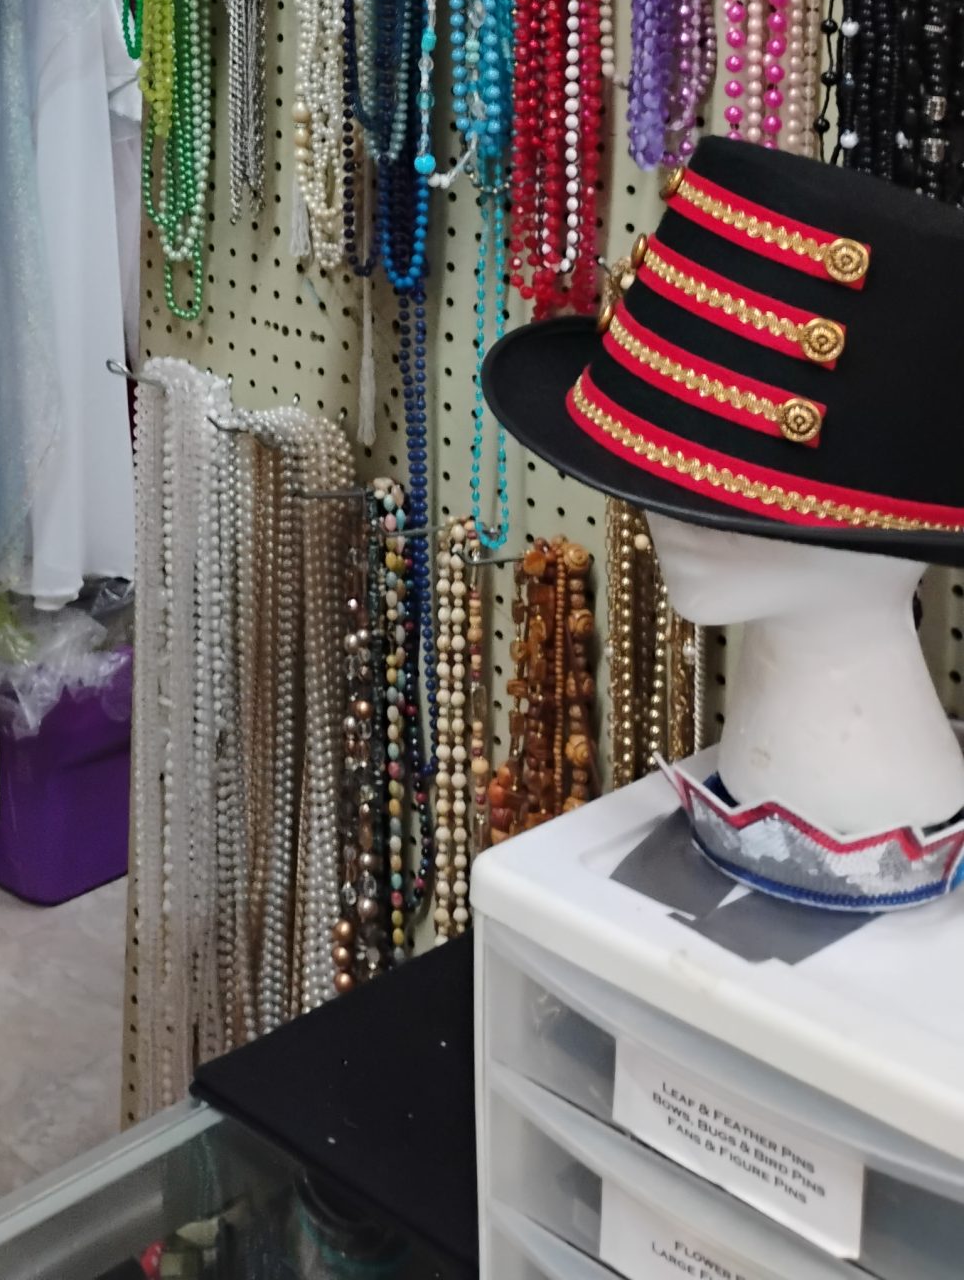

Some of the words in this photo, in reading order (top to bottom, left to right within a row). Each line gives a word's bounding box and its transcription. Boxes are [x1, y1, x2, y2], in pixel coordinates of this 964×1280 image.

[662, 1081, 695, 1108] LEAF
[698, 1103, 710, 1117] &
[713, 1109, 777, 1152] FEATHER
[781, 1145, 815, 1174] PINS
[667, 1115, 701, 1145] FANS
[705, 1139, 716, 1153] &
[719, 1145, 770, 1183] FIGURE
[774, 1176, 807, 1204] PINS
[697, 1119, 736, 1147] BUGS
[739, 1140, 750, 1155] &
[754, 1148, 788, 1175] BIRD
[792, 1169, 826, 1197] PINS
[651, 1240, 696, 1276] LARGE
[674, 1240, 732, 1280] FLOWER
